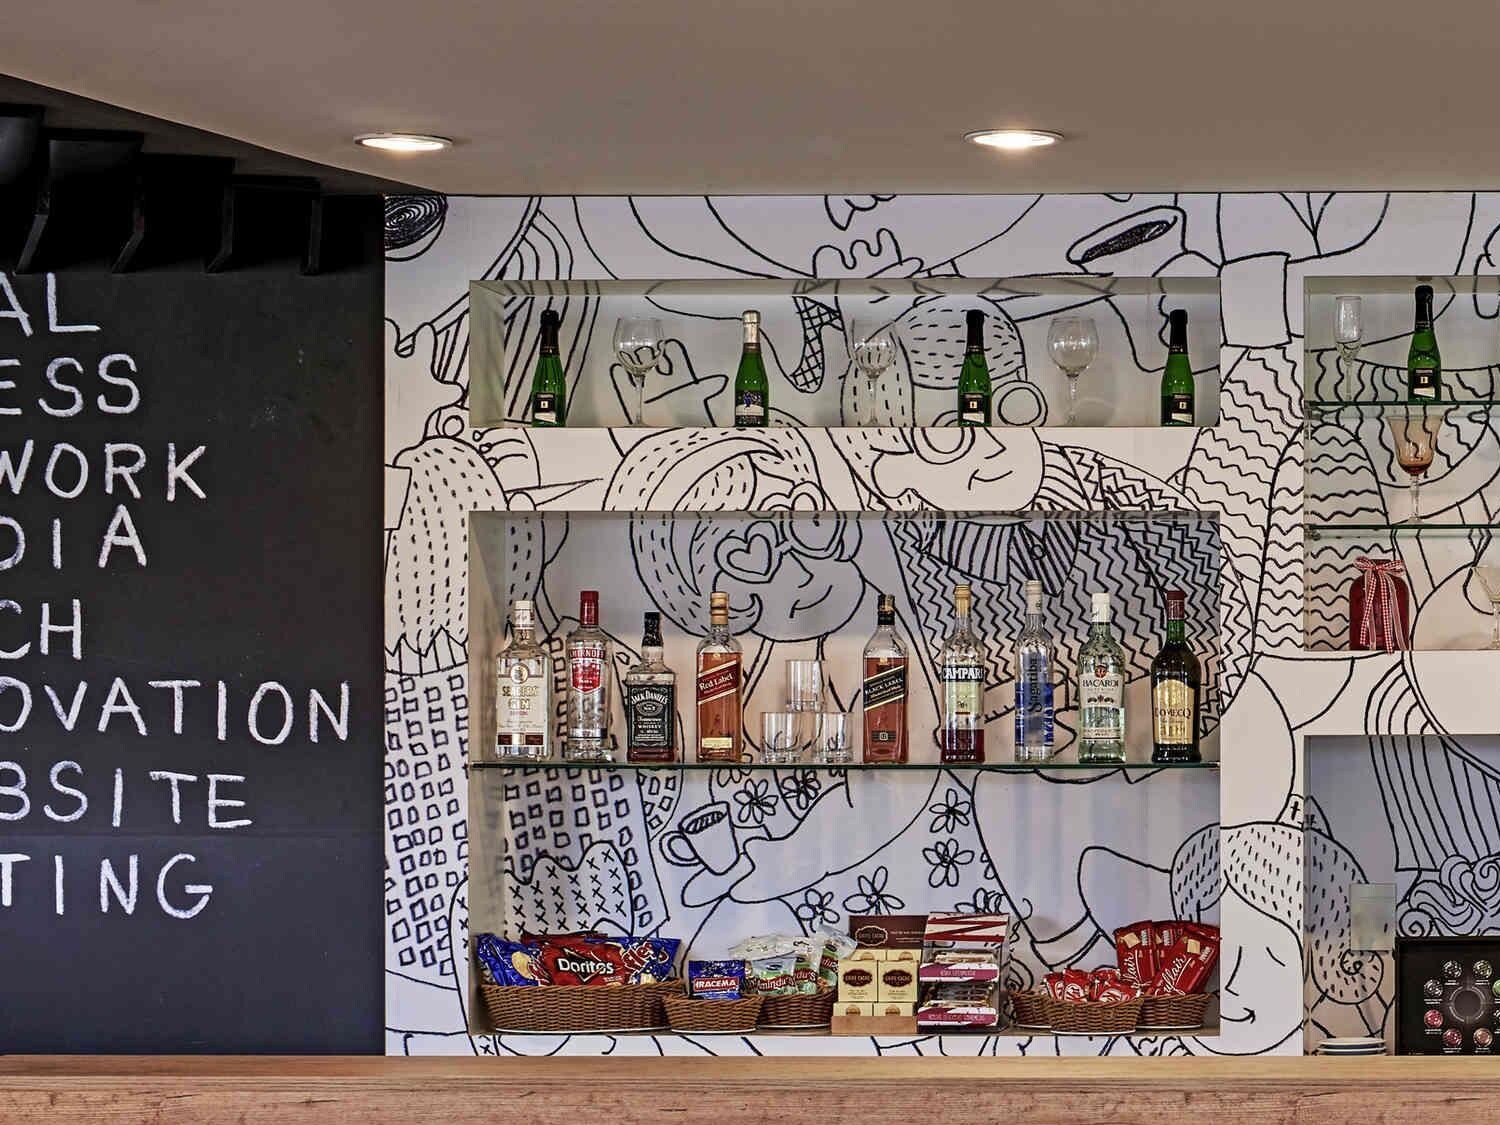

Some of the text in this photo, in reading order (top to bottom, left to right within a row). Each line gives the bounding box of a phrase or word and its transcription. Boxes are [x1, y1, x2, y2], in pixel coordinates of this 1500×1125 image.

[700, 680, 714, 691] Red
[714, 673, 733, 686] Label
[1082, 679, 1119, 688] BACARDI
[0, 853, 213, 919] TING
[557, 958, 614, 975] Doritos
[694, 979, 737, 990] IRACEMA
